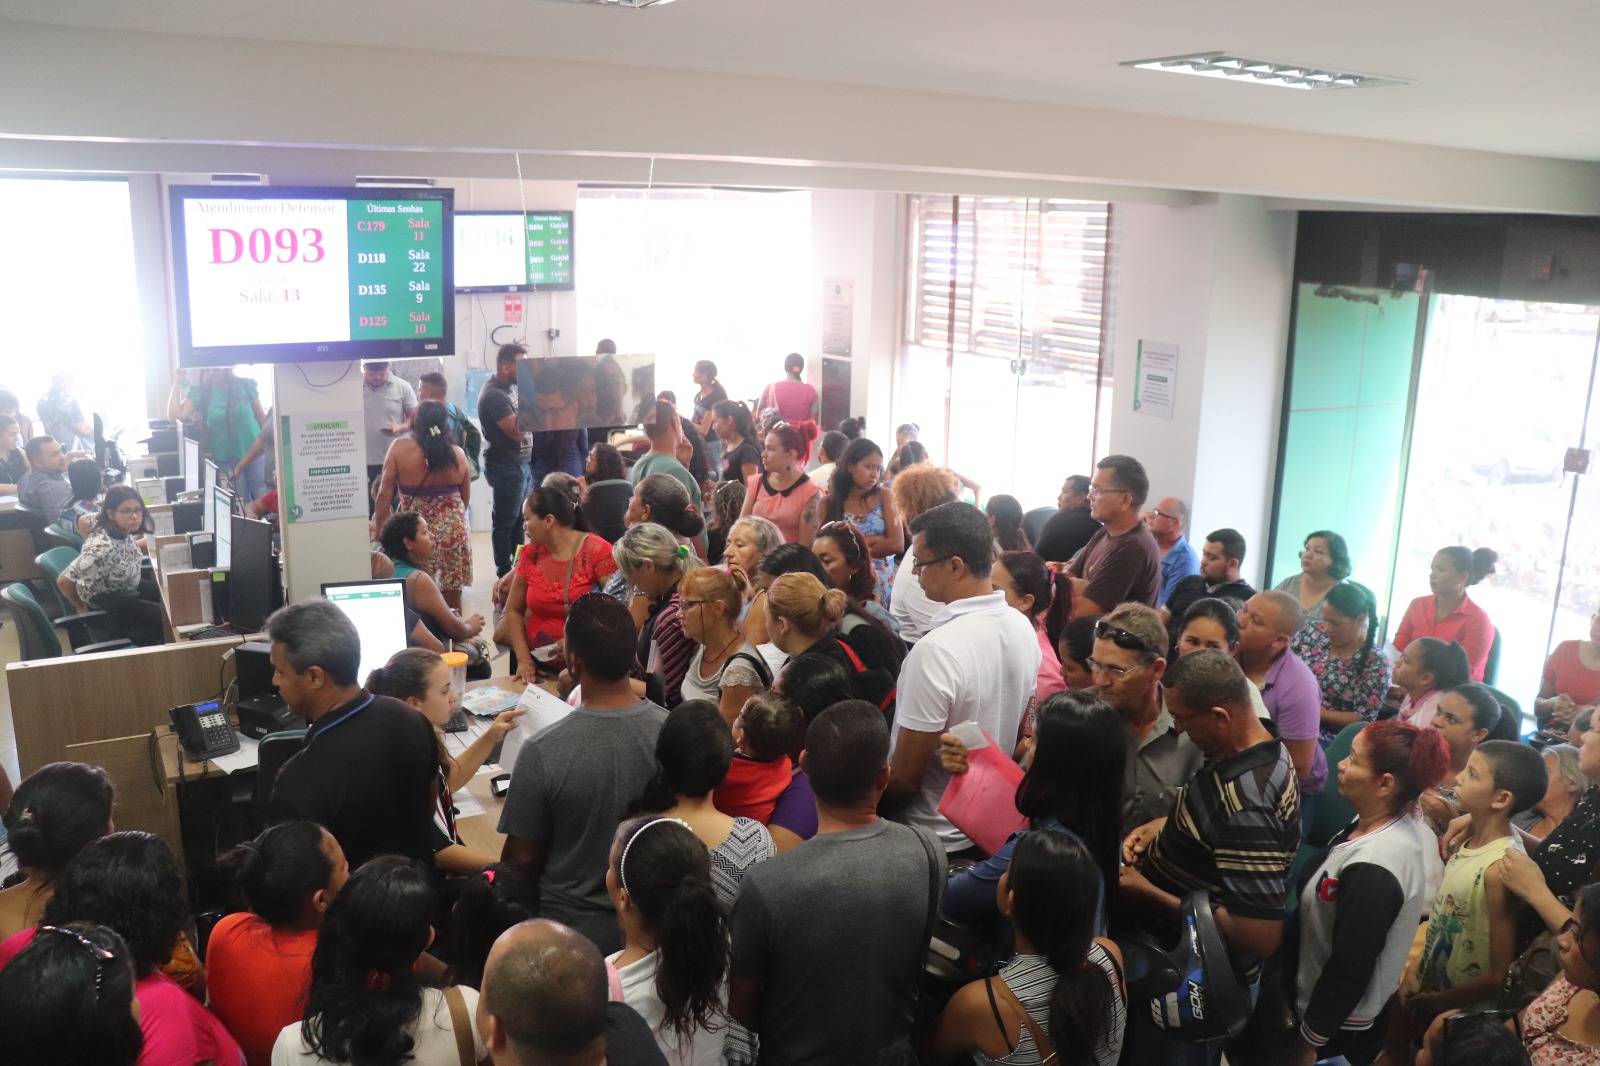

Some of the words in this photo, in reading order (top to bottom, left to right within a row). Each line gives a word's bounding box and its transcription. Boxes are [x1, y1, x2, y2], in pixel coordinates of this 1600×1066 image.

[195, 201, 277, 214] Atendimento
[281, 201, 336, 214] Defensor
[366, 203, 396, 213] Últimas
[397, 204, 423, 213] Senhas
[357, 221, 386, 232] C179
[408, 218, 430, 229] Sala
[413, 231, 425, 241] 11
[207, 228, 326, 264] D093
[358, 253, 386, 263] D118
[408, 249, 431, 260] Sala
[413, 262, 426, 272] 22
[358, 285, 387, 295] D135
[408, 280, 431, 291] Sala
[240, 288, 276, 303] Sala:
[284, 288, 300, 302] 13
[415, 293, 423, 303] 9
[359, 316, 388, 326] D125
[409, 311, 431, 322] Sala
[414, 324, 427, 334] 10
[310, 466, 349, 475] IMPORTANTE:
